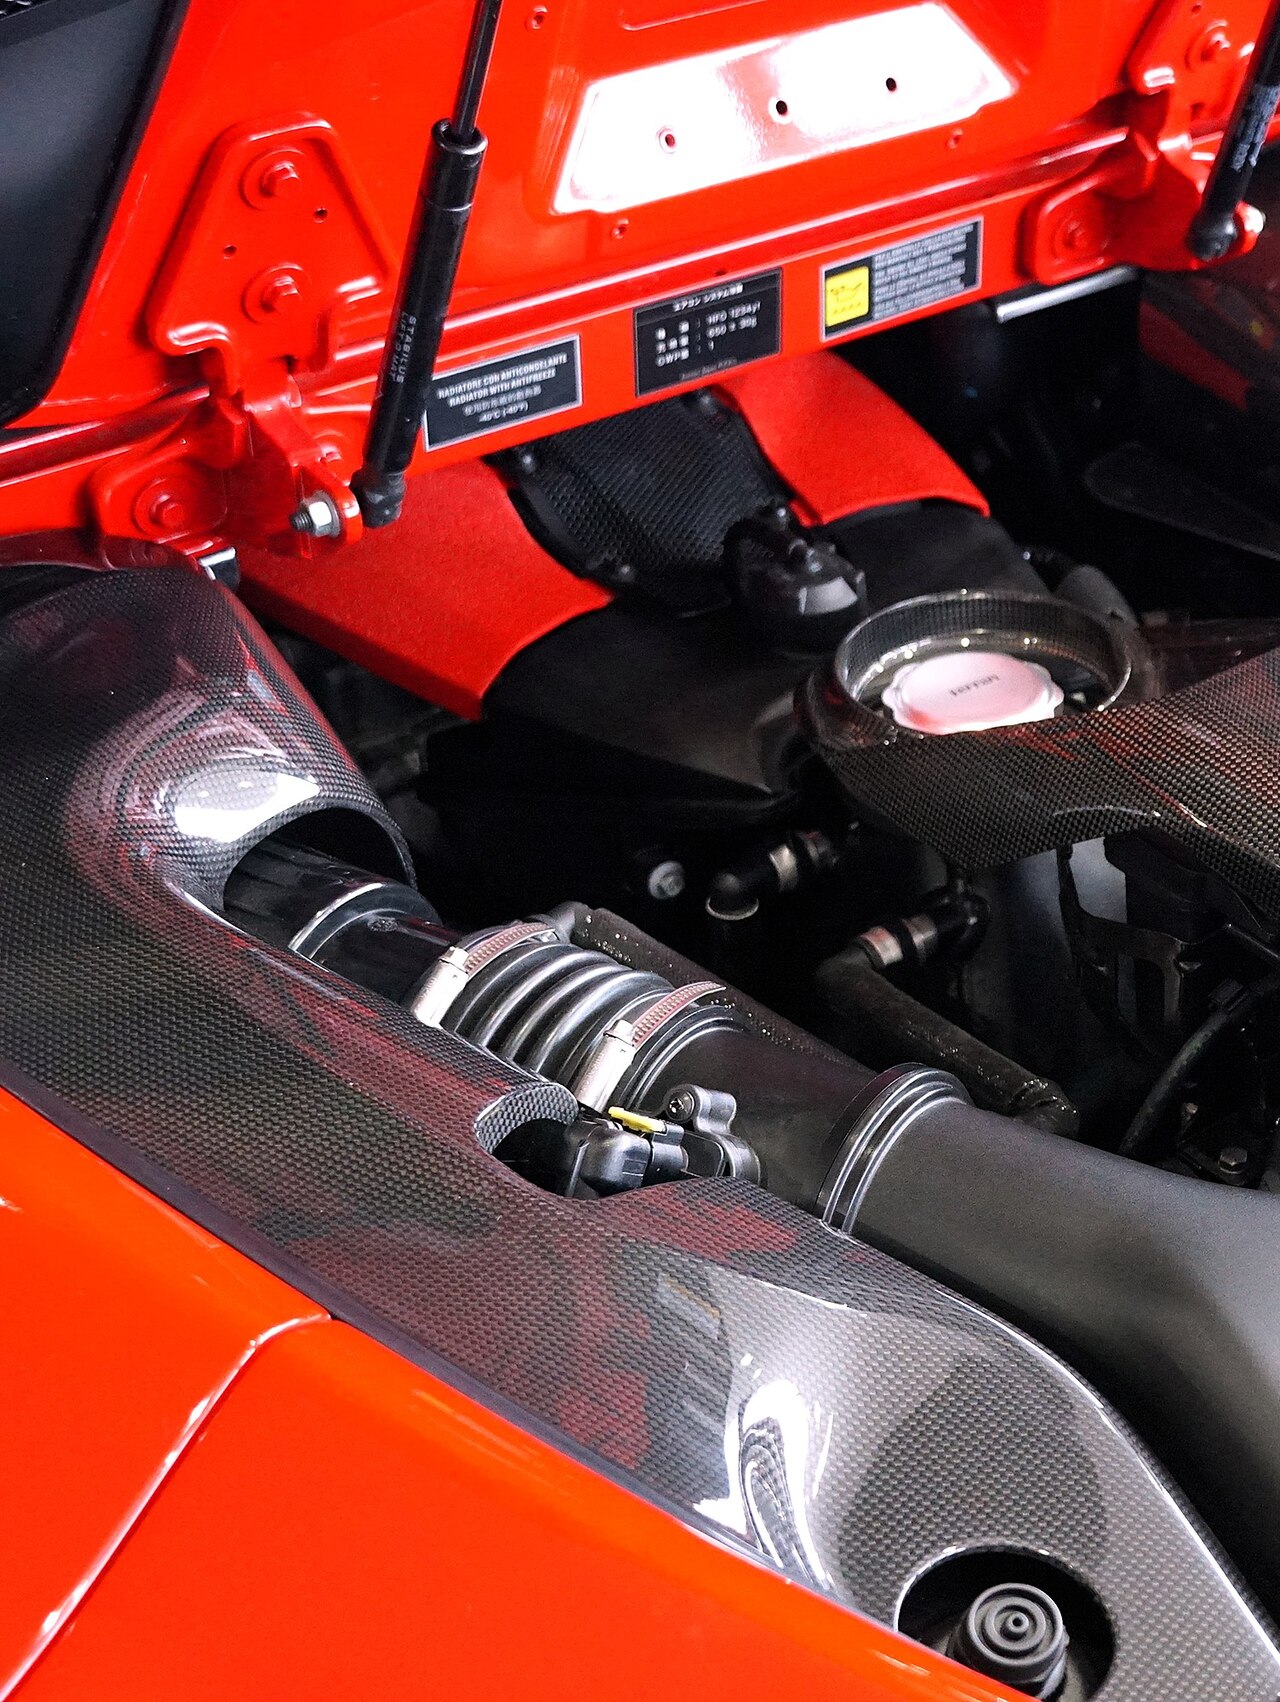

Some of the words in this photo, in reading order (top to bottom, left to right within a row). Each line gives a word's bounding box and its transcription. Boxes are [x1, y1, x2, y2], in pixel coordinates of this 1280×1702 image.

[396, 315, 417, 384] STABILUS
[437, 376, 483, 400] RADIATORE
[483, 373, 500, 387] CON
[449, 388, 489, 408] RADIATOR
[490, 380, 511, 396] WITH
[511, 368, 556, 390] ANTIFREEZE
